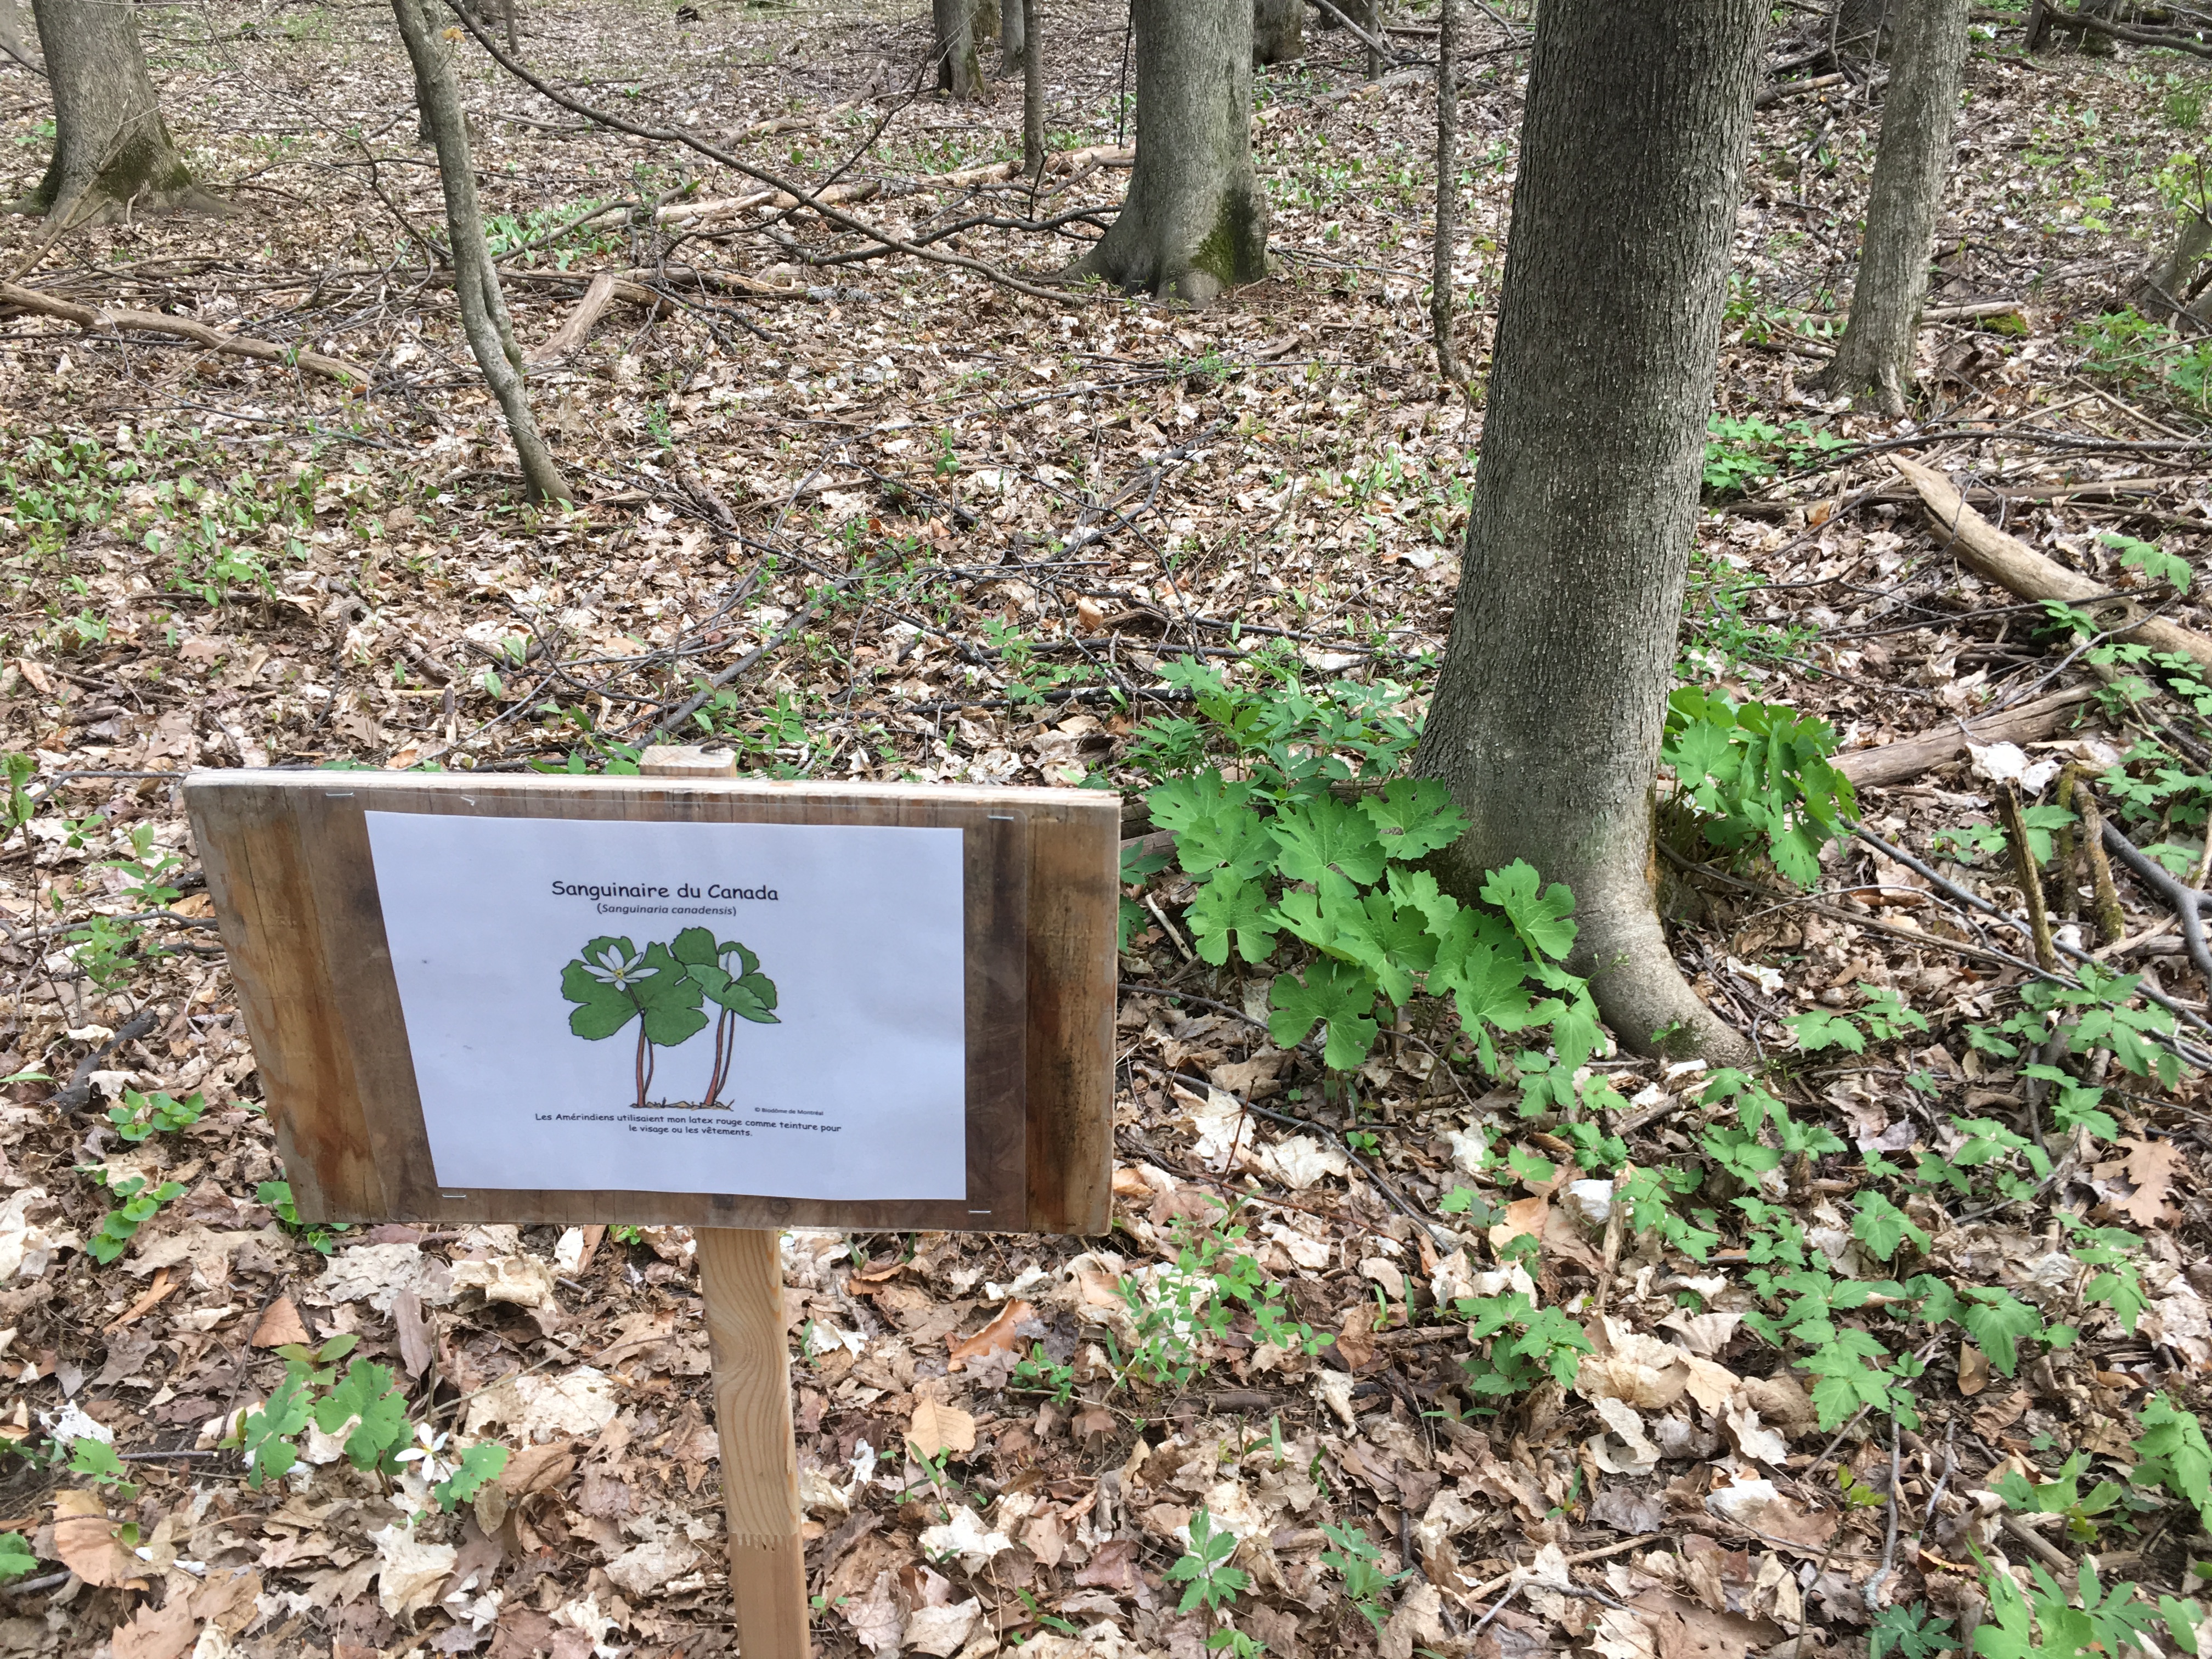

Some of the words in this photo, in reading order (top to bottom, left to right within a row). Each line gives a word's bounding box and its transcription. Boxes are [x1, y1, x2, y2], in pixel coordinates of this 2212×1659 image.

[551, 881, 670, 901] Sanguinaire
[677, 883, 701, 899] du
[707, 884, 779, 901] Canada
[596, 902, 669, 915] (Sanguinaria
[671, 905, 737, 917] canadensis)
[555, 1113, 614, 1121] Amérindiens
[617, 1114, 664, 1122] utilisaient
[689, 1116, 713, 1124] latex
[716, 1119, 743, 1127] rouge
[779, 1121, 819, 1131] teinture
[820, 1125, 842, 1133] pour
[629, 1124, 638, 1132] le
[639, 1125, 669, 1135] visage
[685, 1126, 699, 1134] les
[701, 1126, 753, 1136] vêtements.
